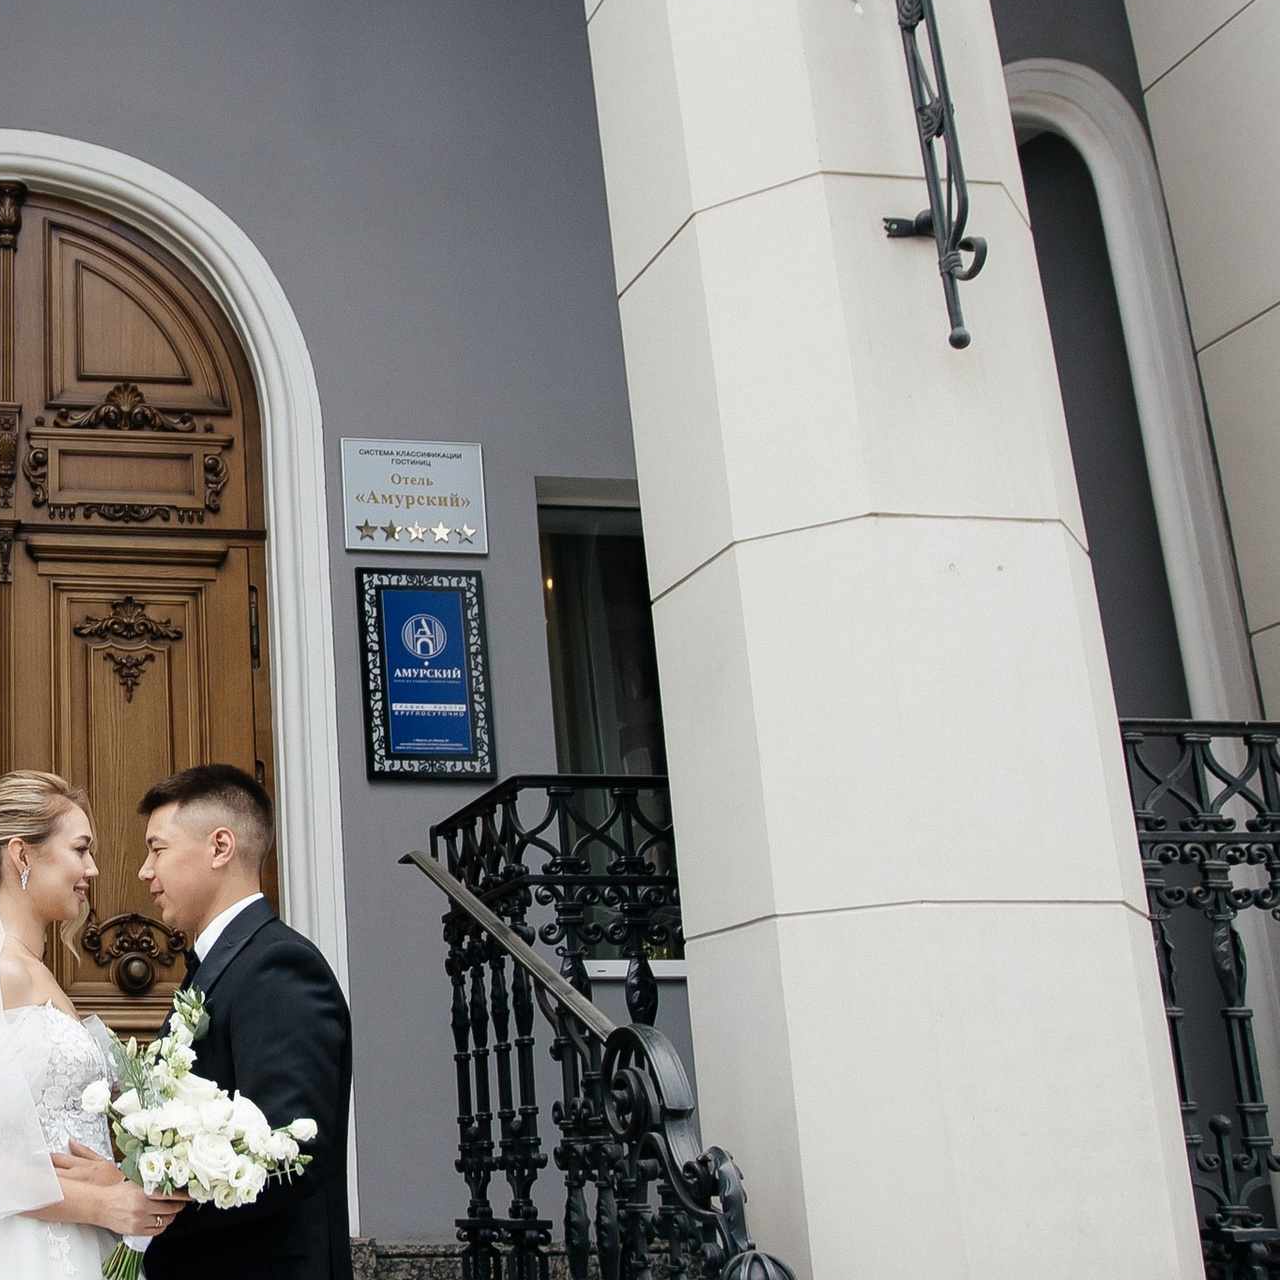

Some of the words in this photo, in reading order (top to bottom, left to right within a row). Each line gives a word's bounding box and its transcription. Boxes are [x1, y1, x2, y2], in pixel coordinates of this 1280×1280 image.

[358, 448, 395, 457] СИСТЕМА
[396, 450, 463, 460] КЛАССИФИКАЦИИ
[391, 458, 432, 467] ГОСТИНИЦ
[390, 472, 434, 486] Отель
[355, 489, 471, 509] «Амурский»
[393, 667, 462, 679] АМУРСКИЙ
